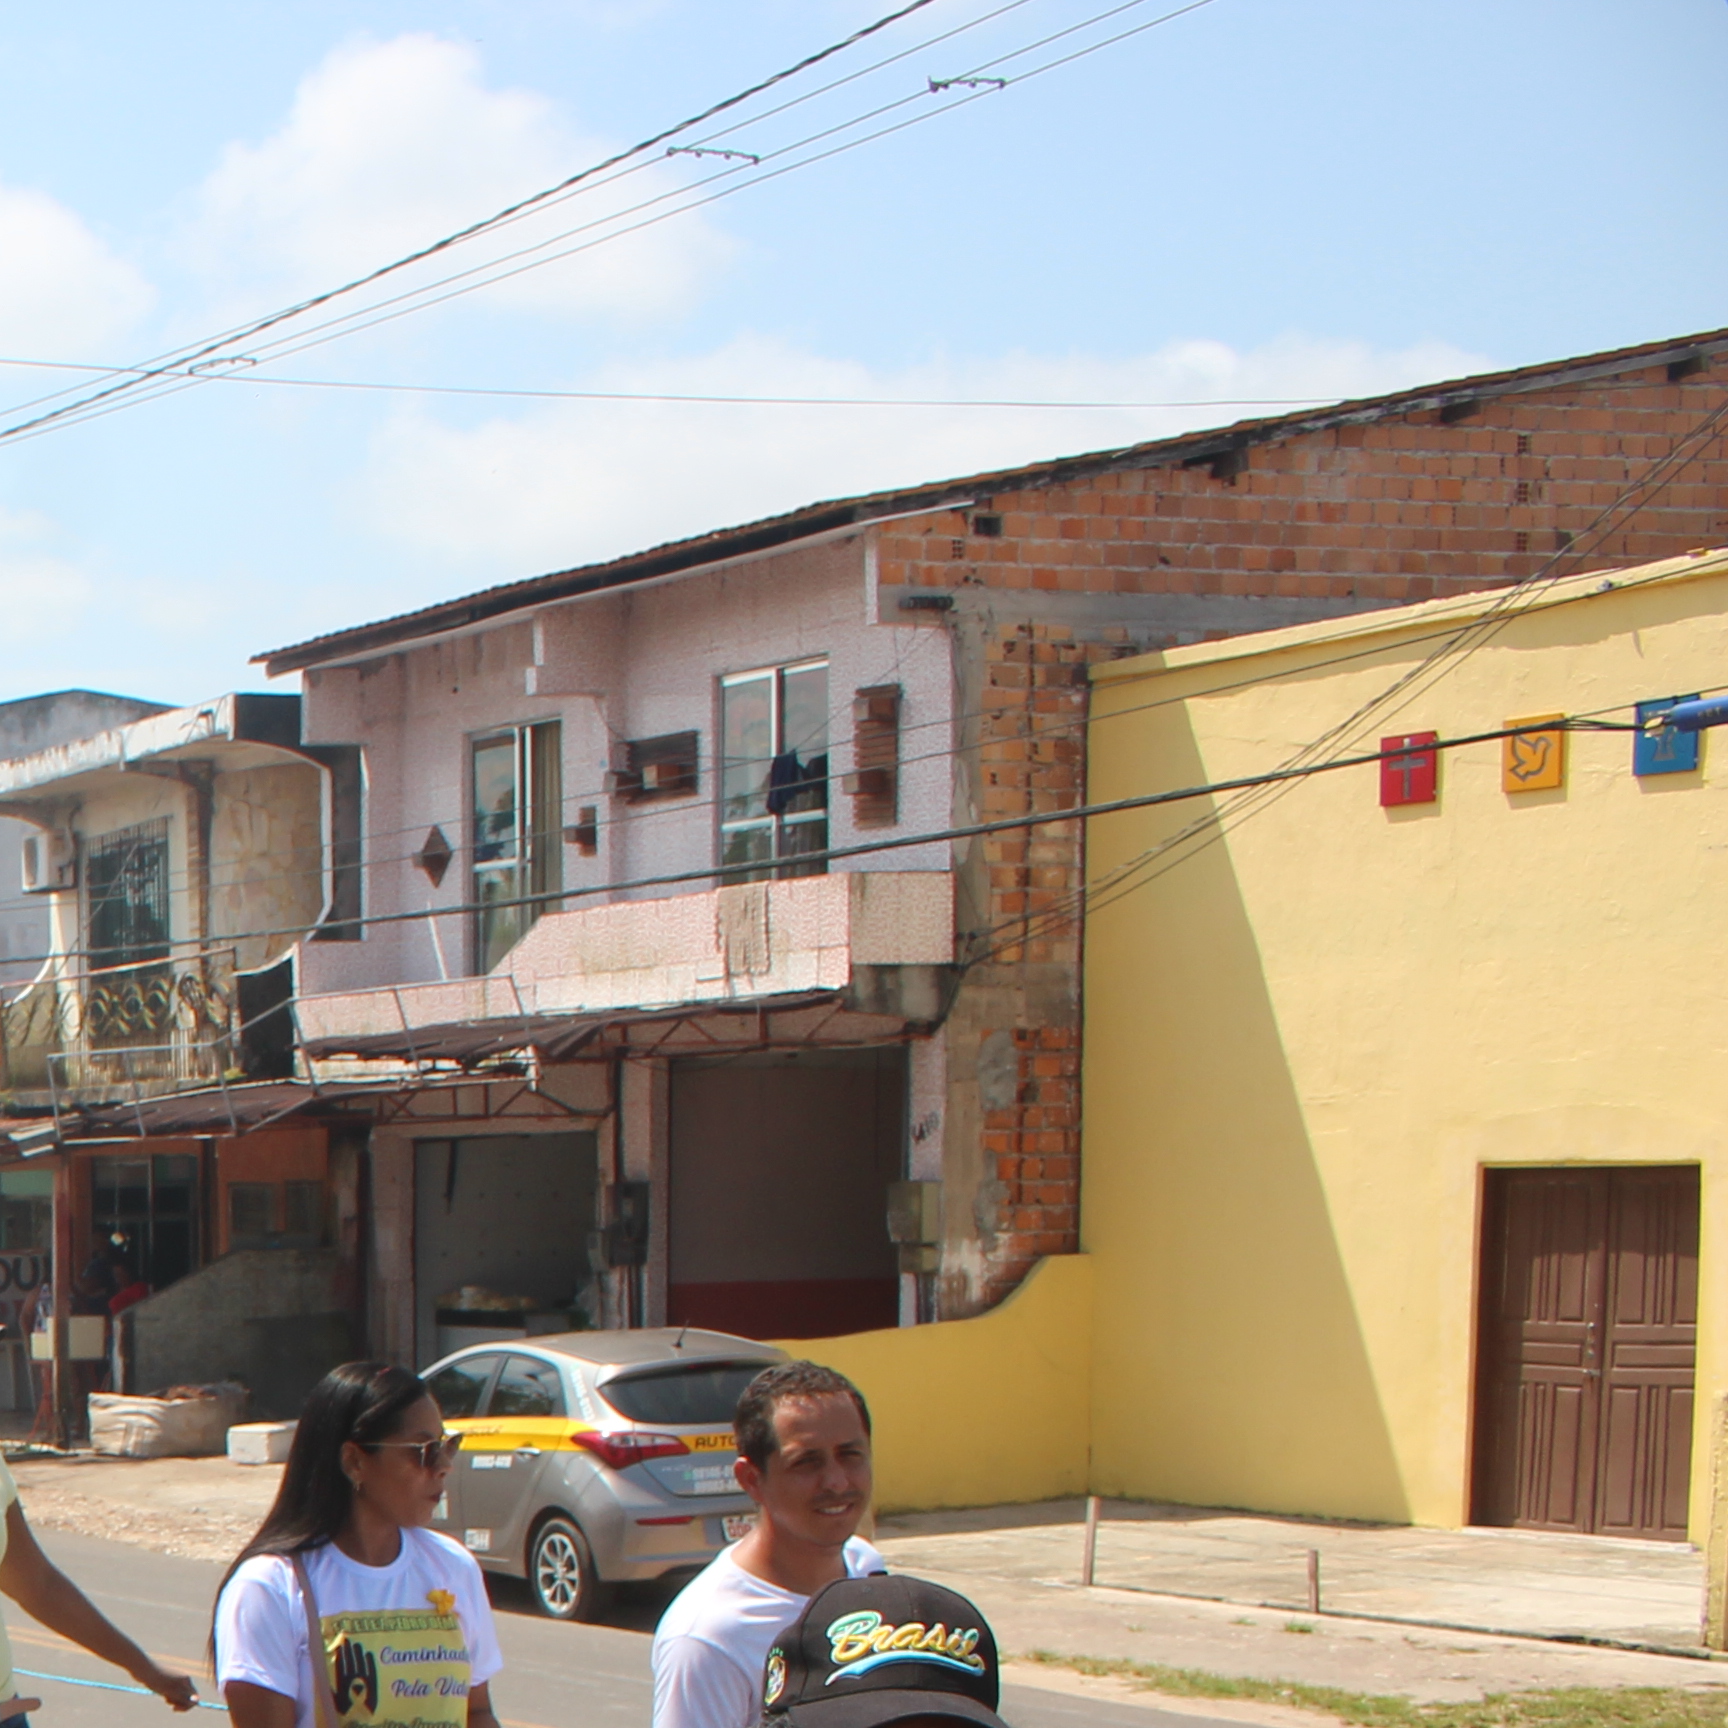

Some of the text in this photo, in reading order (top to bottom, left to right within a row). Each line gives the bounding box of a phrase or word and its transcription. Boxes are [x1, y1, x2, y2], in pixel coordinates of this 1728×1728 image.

[827, 1610, 986, 1671] Brasil
[379, 1644, 470, 1665] Caminhad
[432, 1675, 470, 1697] Vid
